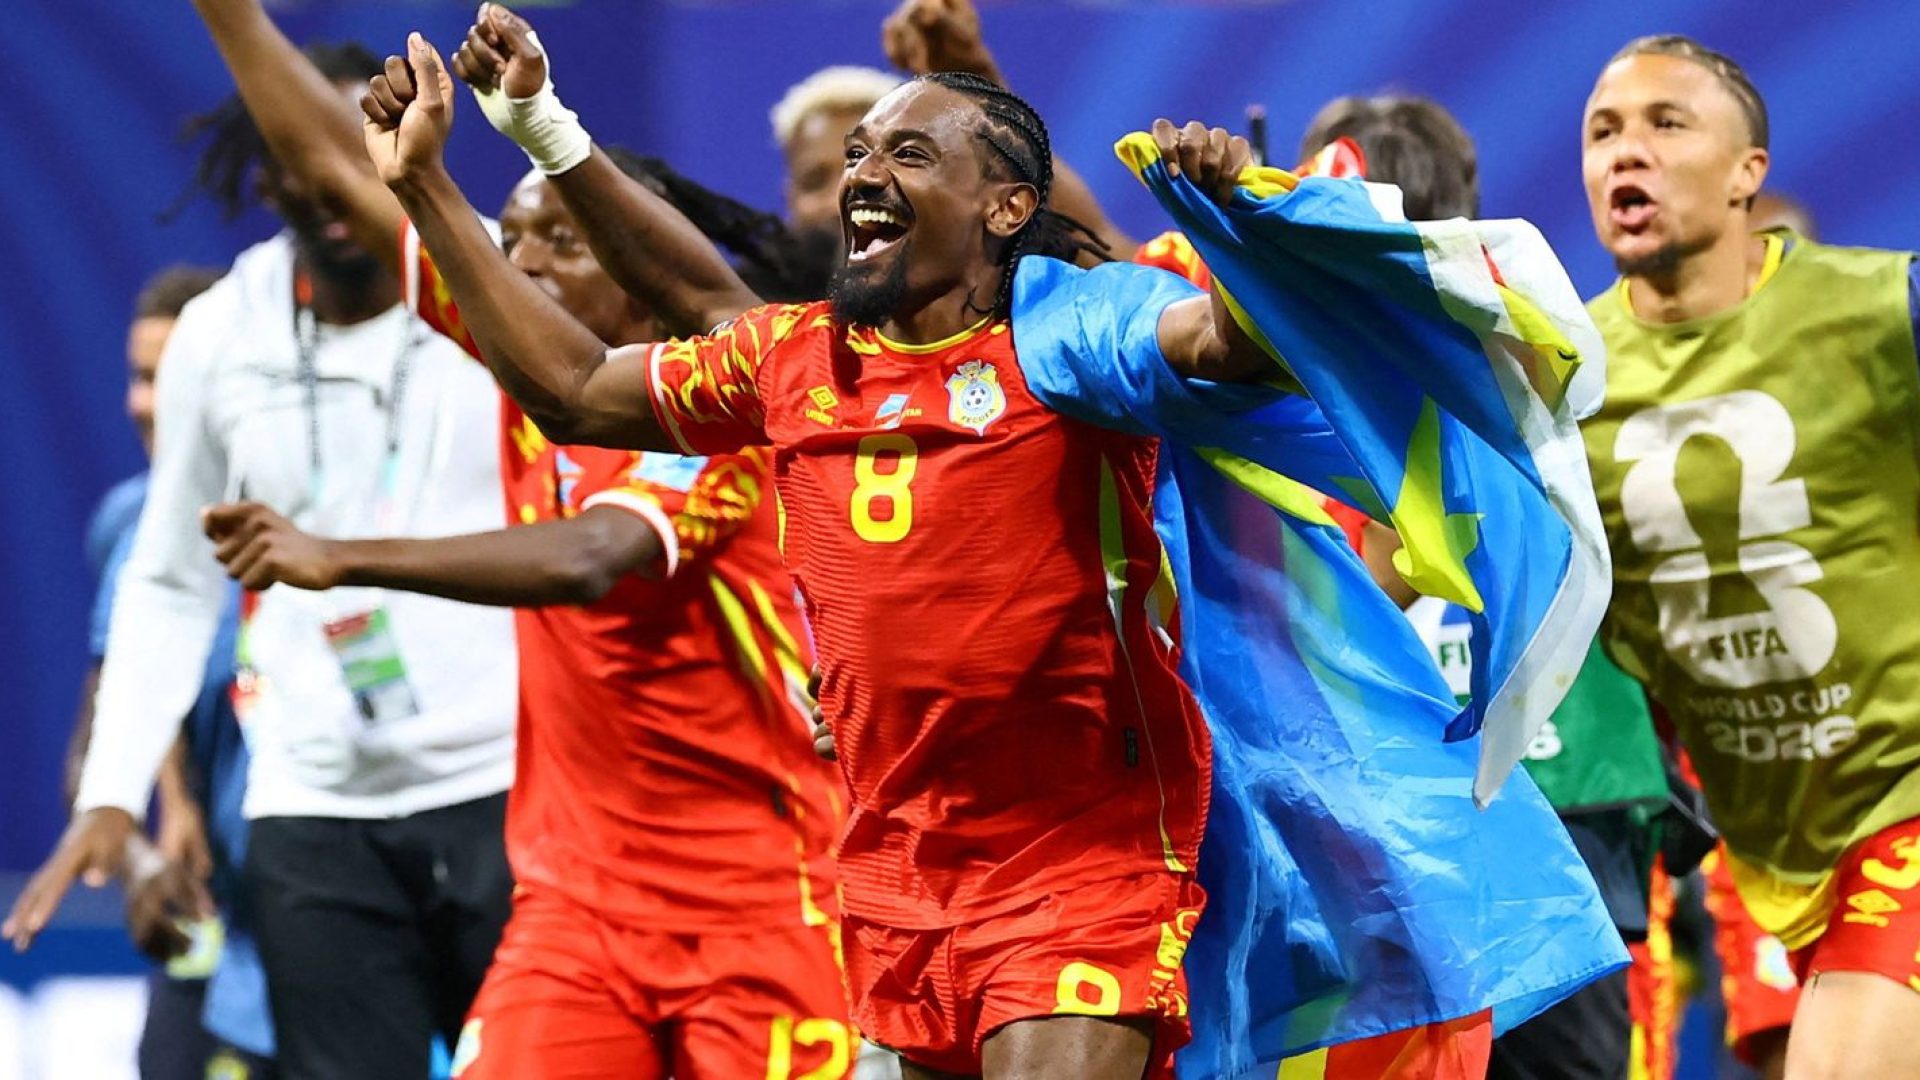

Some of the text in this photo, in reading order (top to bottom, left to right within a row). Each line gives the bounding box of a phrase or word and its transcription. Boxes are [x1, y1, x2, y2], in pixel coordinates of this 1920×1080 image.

[850, 433, 918, 542] 8
[1707, 626, 1789, 661] FIFA
[1791, 682, 1852, 716] CUP
[1704, 714, 1858, 763] 2026
[765, 1015, 849, 1080] 12
